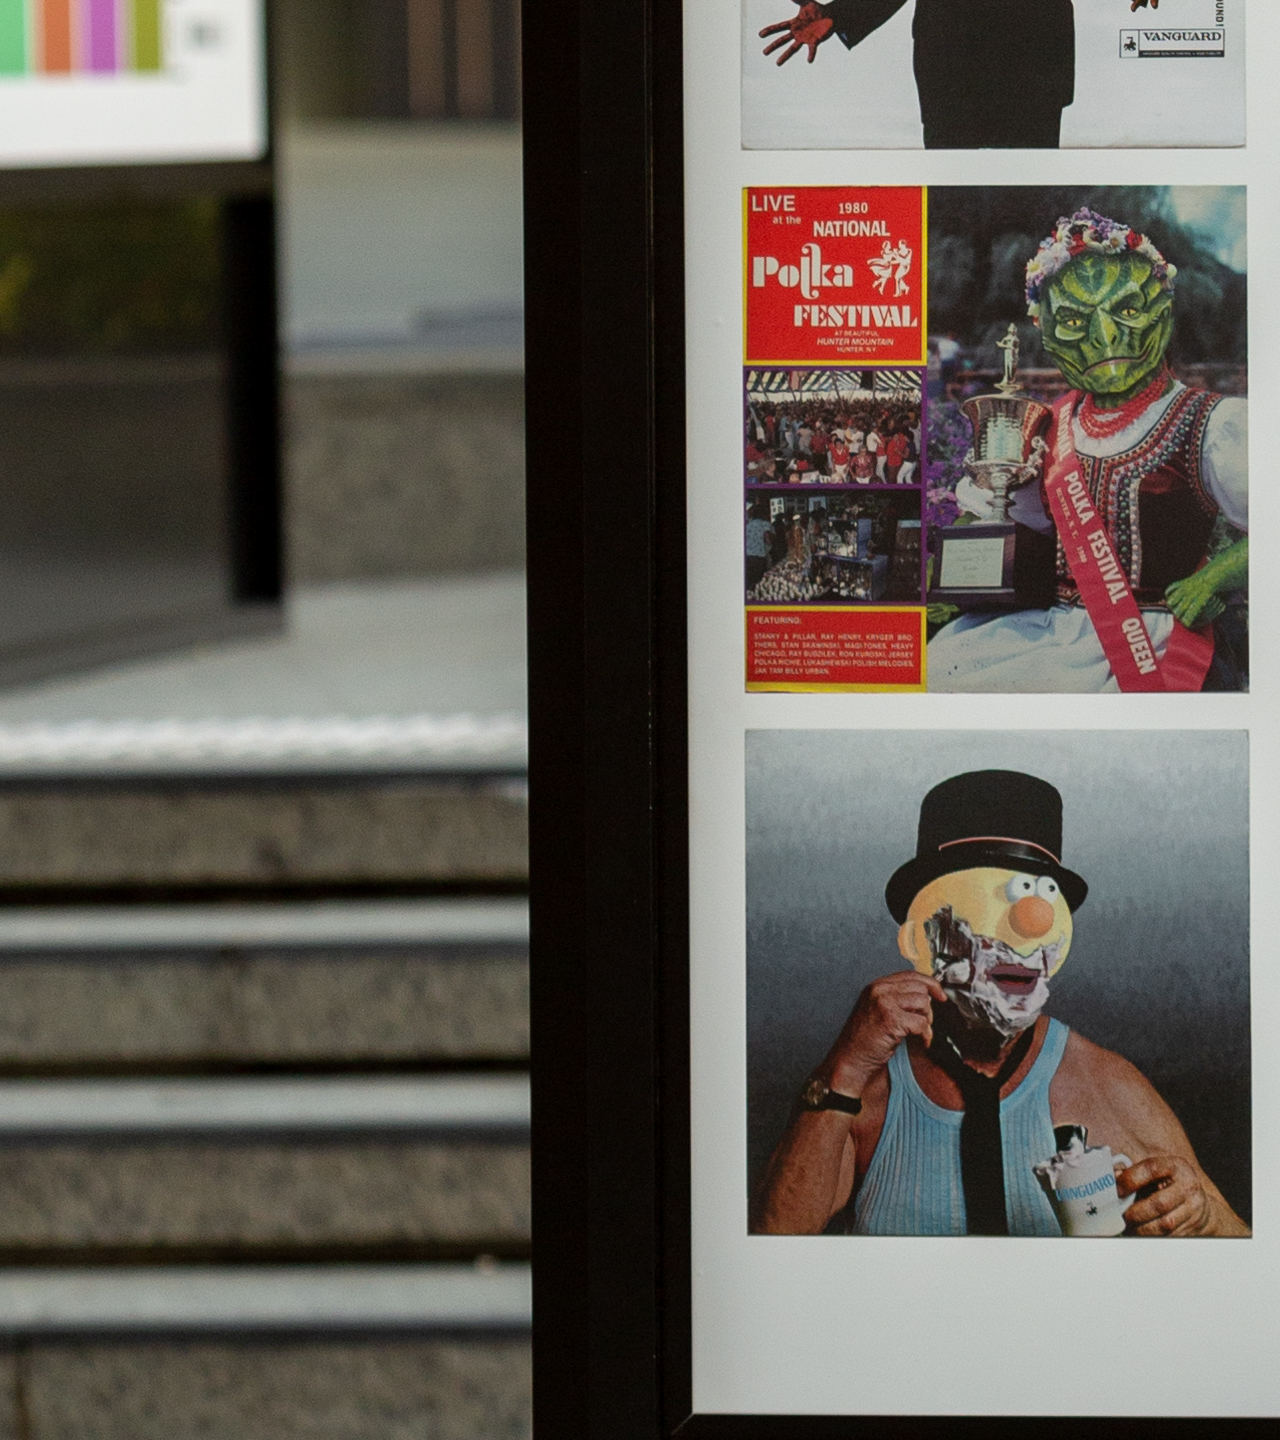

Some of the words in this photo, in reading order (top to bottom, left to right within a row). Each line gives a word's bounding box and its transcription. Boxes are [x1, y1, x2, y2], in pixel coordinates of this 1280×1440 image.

[1143, 32, 1222, 41] VANGUARD
[752, 194, 796, 212] LIVE
[838, 202, 869, 214] 1980
[772, 216, 783, 224] at
[785, 215, 801, 224] the
[813, 220, 891, 237] NATIONAL
[752, 242, 854, 300] Polka
[794, 305, 918, 327] FESTIVAL
[816, 338, 850, 346] HUNTER
[851, 338, 894, 346] MOUNTAIN
[1064, 470, 1095, 526] POLKA
[1087, 529, 1129, 605] FESTIVAL
[1121, 617, 1157, 675] QUEEN
